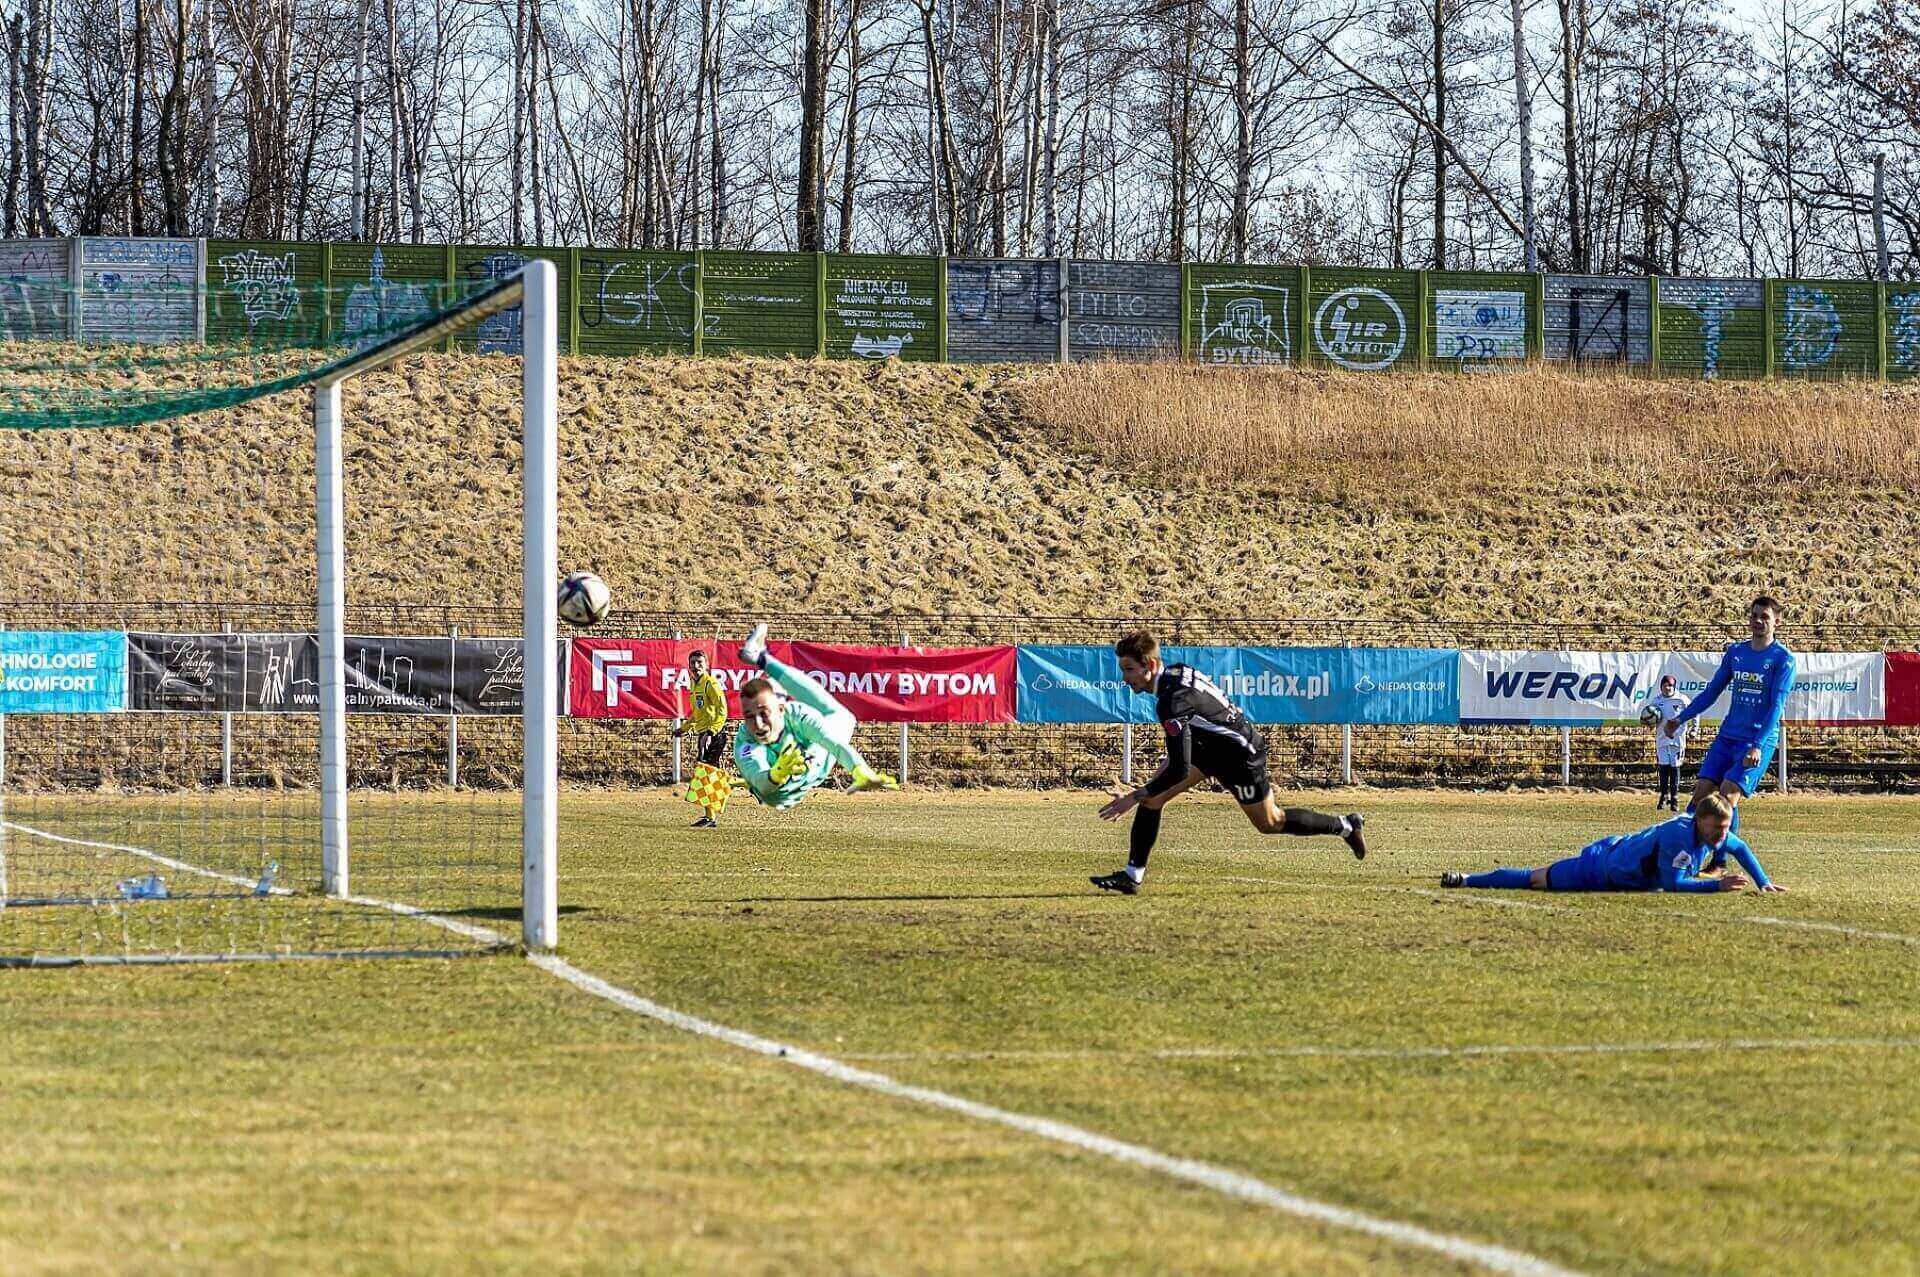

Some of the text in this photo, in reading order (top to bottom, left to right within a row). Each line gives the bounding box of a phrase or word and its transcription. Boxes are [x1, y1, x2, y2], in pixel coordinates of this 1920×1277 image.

[844, 279, 907, 294] NIETAK.EU
[1077, 291, 1148, 317] TYLKO
[0, 652, 97, 669] HNOLOGIE
[6, 675, 97, 691] KOMFORT
[803, 669, 891, 695] ORMY
[898, 672, 997, 696] BYTOM
[1055, 680, 1090, 690] NIEDAX
[1377, 681, 1447, 692] NIEDAX GROUP
